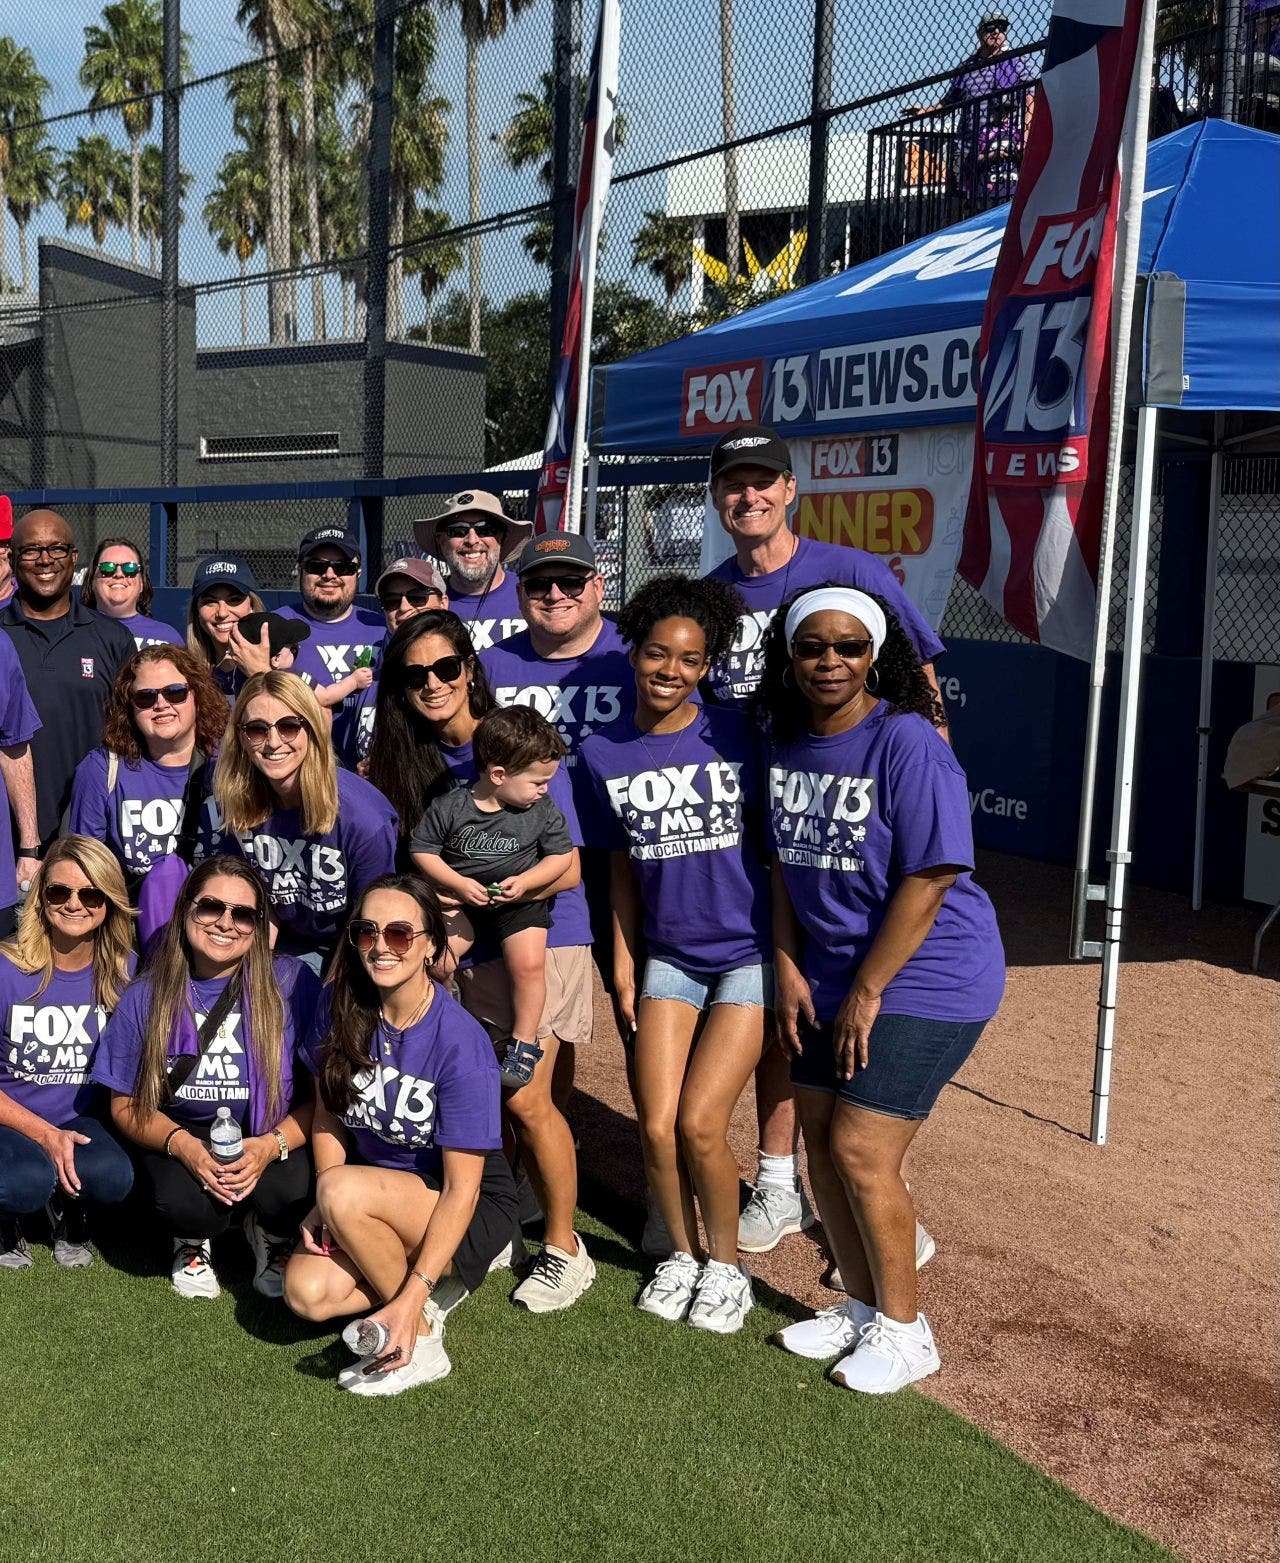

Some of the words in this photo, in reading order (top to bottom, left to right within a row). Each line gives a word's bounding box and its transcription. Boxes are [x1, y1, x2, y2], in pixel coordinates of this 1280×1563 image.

[1023, 204, 1108, 285] FO
[1004, 296, 1091, 432] 13
[686, 367, 755, 427] FOX
[771, 354, 810, 422] 13
[814, 440, 862, 477] FOX
[871, 438, 892, 473] 13
[799, 491, 922, 552] NNER
[731, 609, 778, 652] OX
[584, 686, 622, 723] 13
[606, 764, 705, 818] FOX
[704, 762, 744, 803] 13
[769, 767, 835, 818] FOX
[832, 776, 874, 822] 13
[970, 788, 1028, 820] yCare
[234, 828, 308, 875] FOX
[309, 844, 345, 882] 13
[451, 825, 520, 853] Adidas
[630, 845, 654, 860] OX
[841, 857, 865, 872] BAY
[326, 897, 347, 911] BAY
[11, 1004, 93, 1046] FOX
[35, 1073, 64, 1085] LOCAL
[184, 1086, 218, 1100] LOCAL
[220, 1087, 249, 1100] TAM
[394, 1074, 435, 1122] 13
